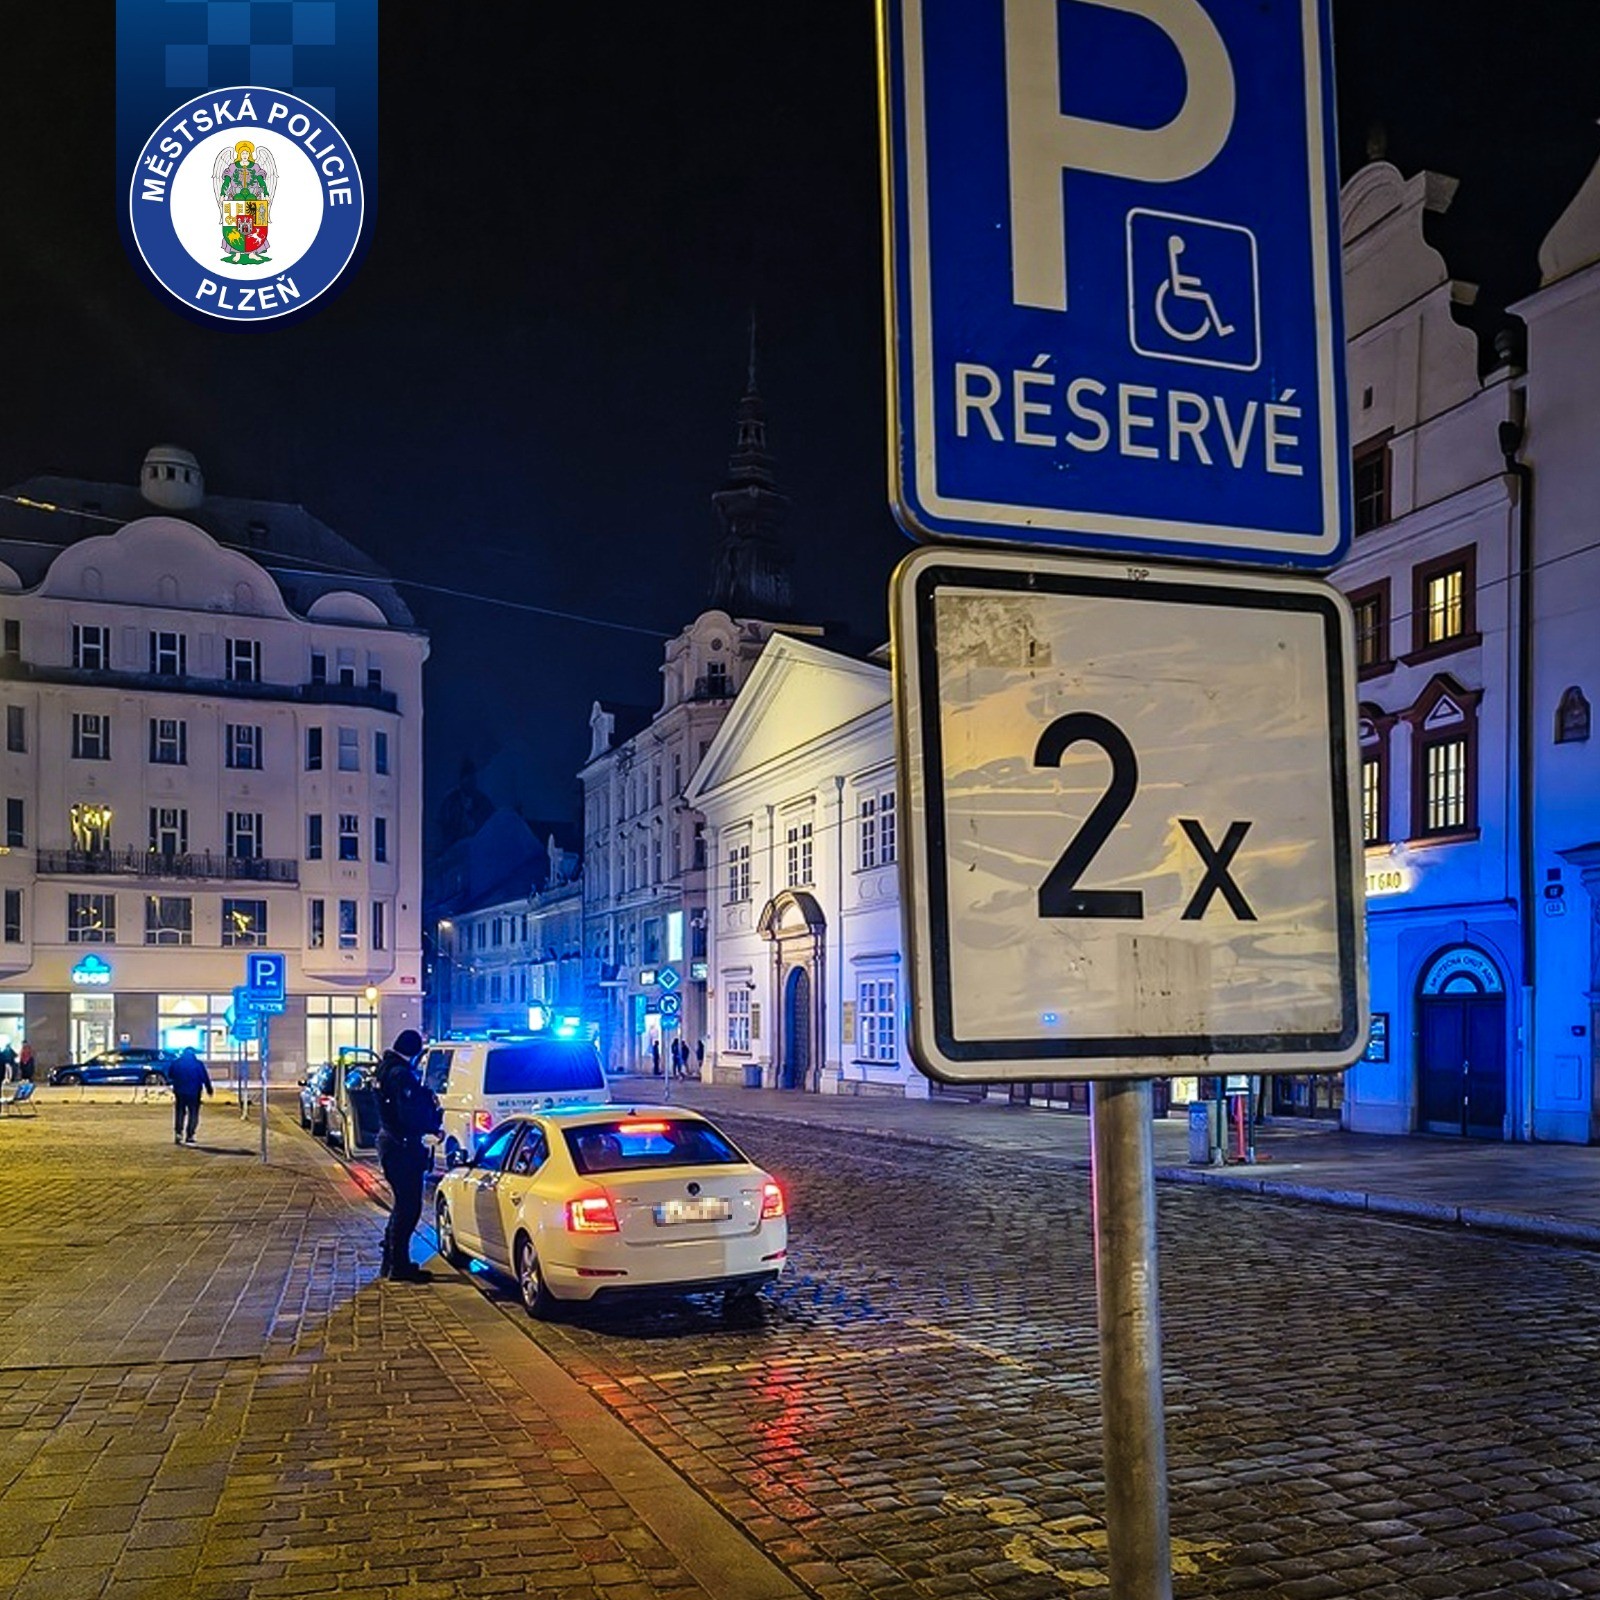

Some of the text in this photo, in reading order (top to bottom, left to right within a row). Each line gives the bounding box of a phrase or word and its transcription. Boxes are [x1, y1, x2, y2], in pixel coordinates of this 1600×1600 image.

[1004, 0, 1236, 312] P
[955, 353, 1303, 476] RÉSERVÉ
[256, 960, 275, 986] P
